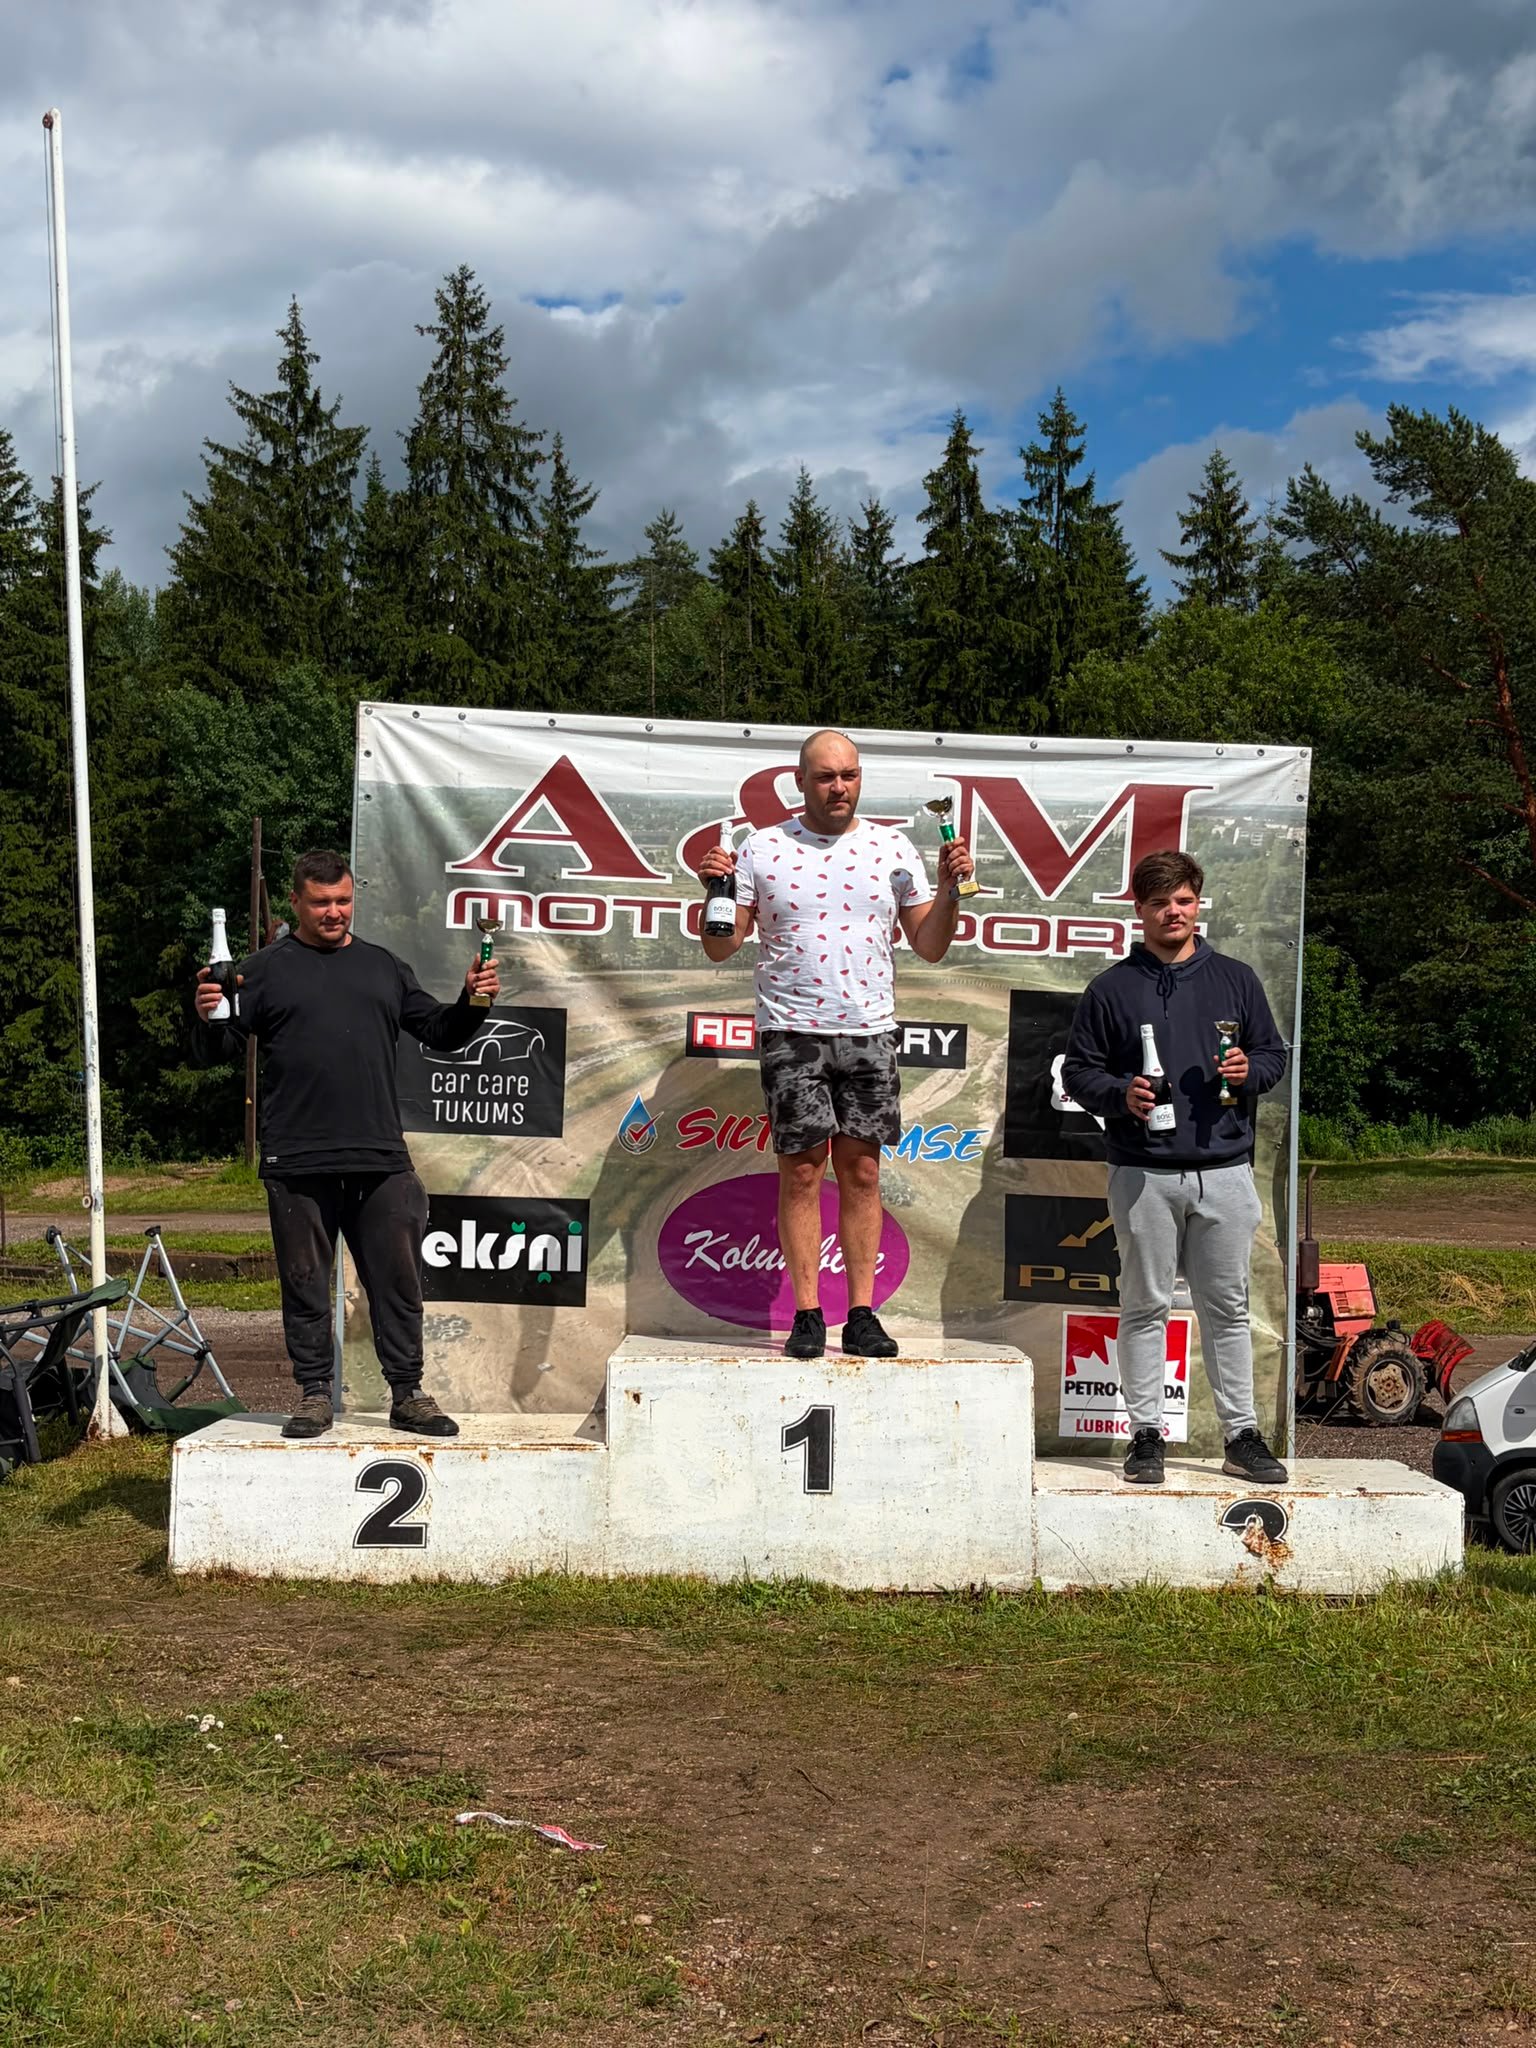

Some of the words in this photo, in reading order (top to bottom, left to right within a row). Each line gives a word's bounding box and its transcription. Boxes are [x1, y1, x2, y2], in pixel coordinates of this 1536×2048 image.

[696, 1018, 753, 1047] AG
[431, 1072, 471, 1094] car
[477, 1074, 529, 1097] care
[432, 1100, 525, 1125] TUKUMS
[684, 1229, 885, 1275] Kolubie
[1076, 1418, 1170, 1437] LUBRICS
[781, 1404, 835, 1494] 1
[352, 1458, 428, 1549] 2
